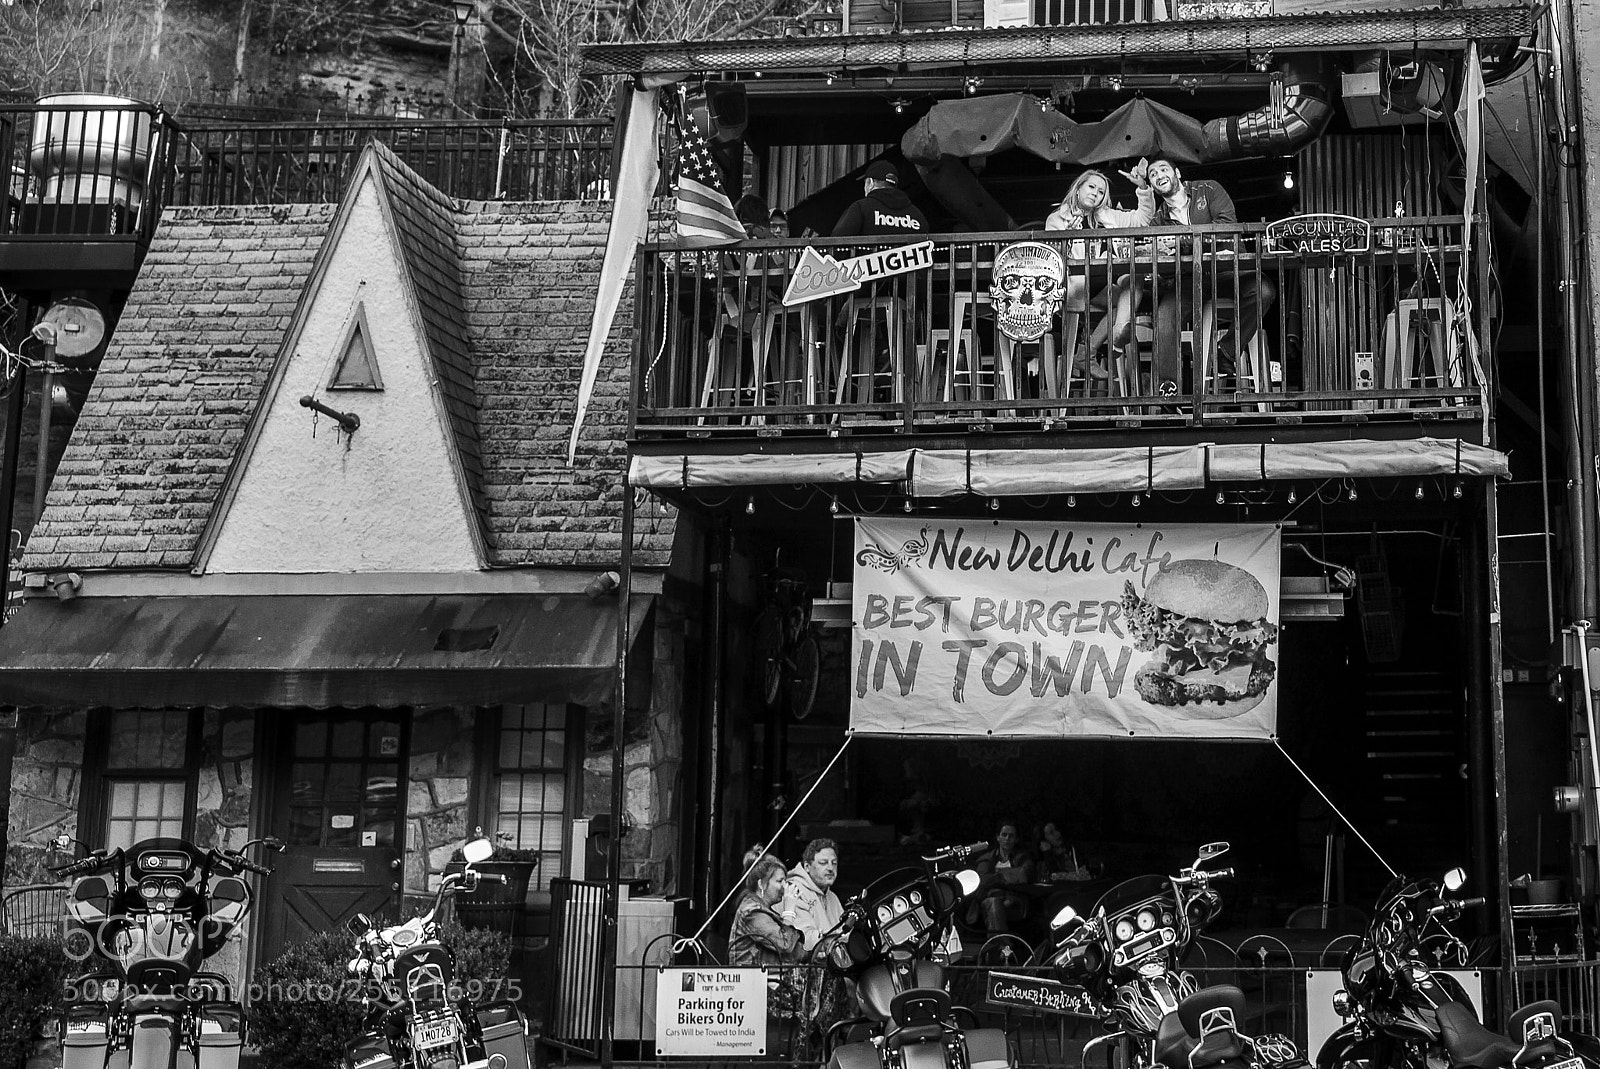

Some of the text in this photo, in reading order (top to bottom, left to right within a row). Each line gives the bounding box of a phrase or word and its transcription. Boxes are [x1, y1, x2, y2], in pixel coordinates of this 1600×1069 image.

[874, 210, 921, 230] horde
[1272, 220, 1366, 253] LAGUNITAS ALES
[792, 245, 931, 293] Coors LIGHT
[928, 527, 1172, 589] New Delhi Cafe
[863, 594, 1125, 639] BEST BURGER
[856, 640, 1132, 703] IN TOWN
[677, 1012, 745, 1027] Bikers Only
[678, 997, 745, 1012] Parking for
[665, 1028, 756, 1036] Cars Will be Towed to India
